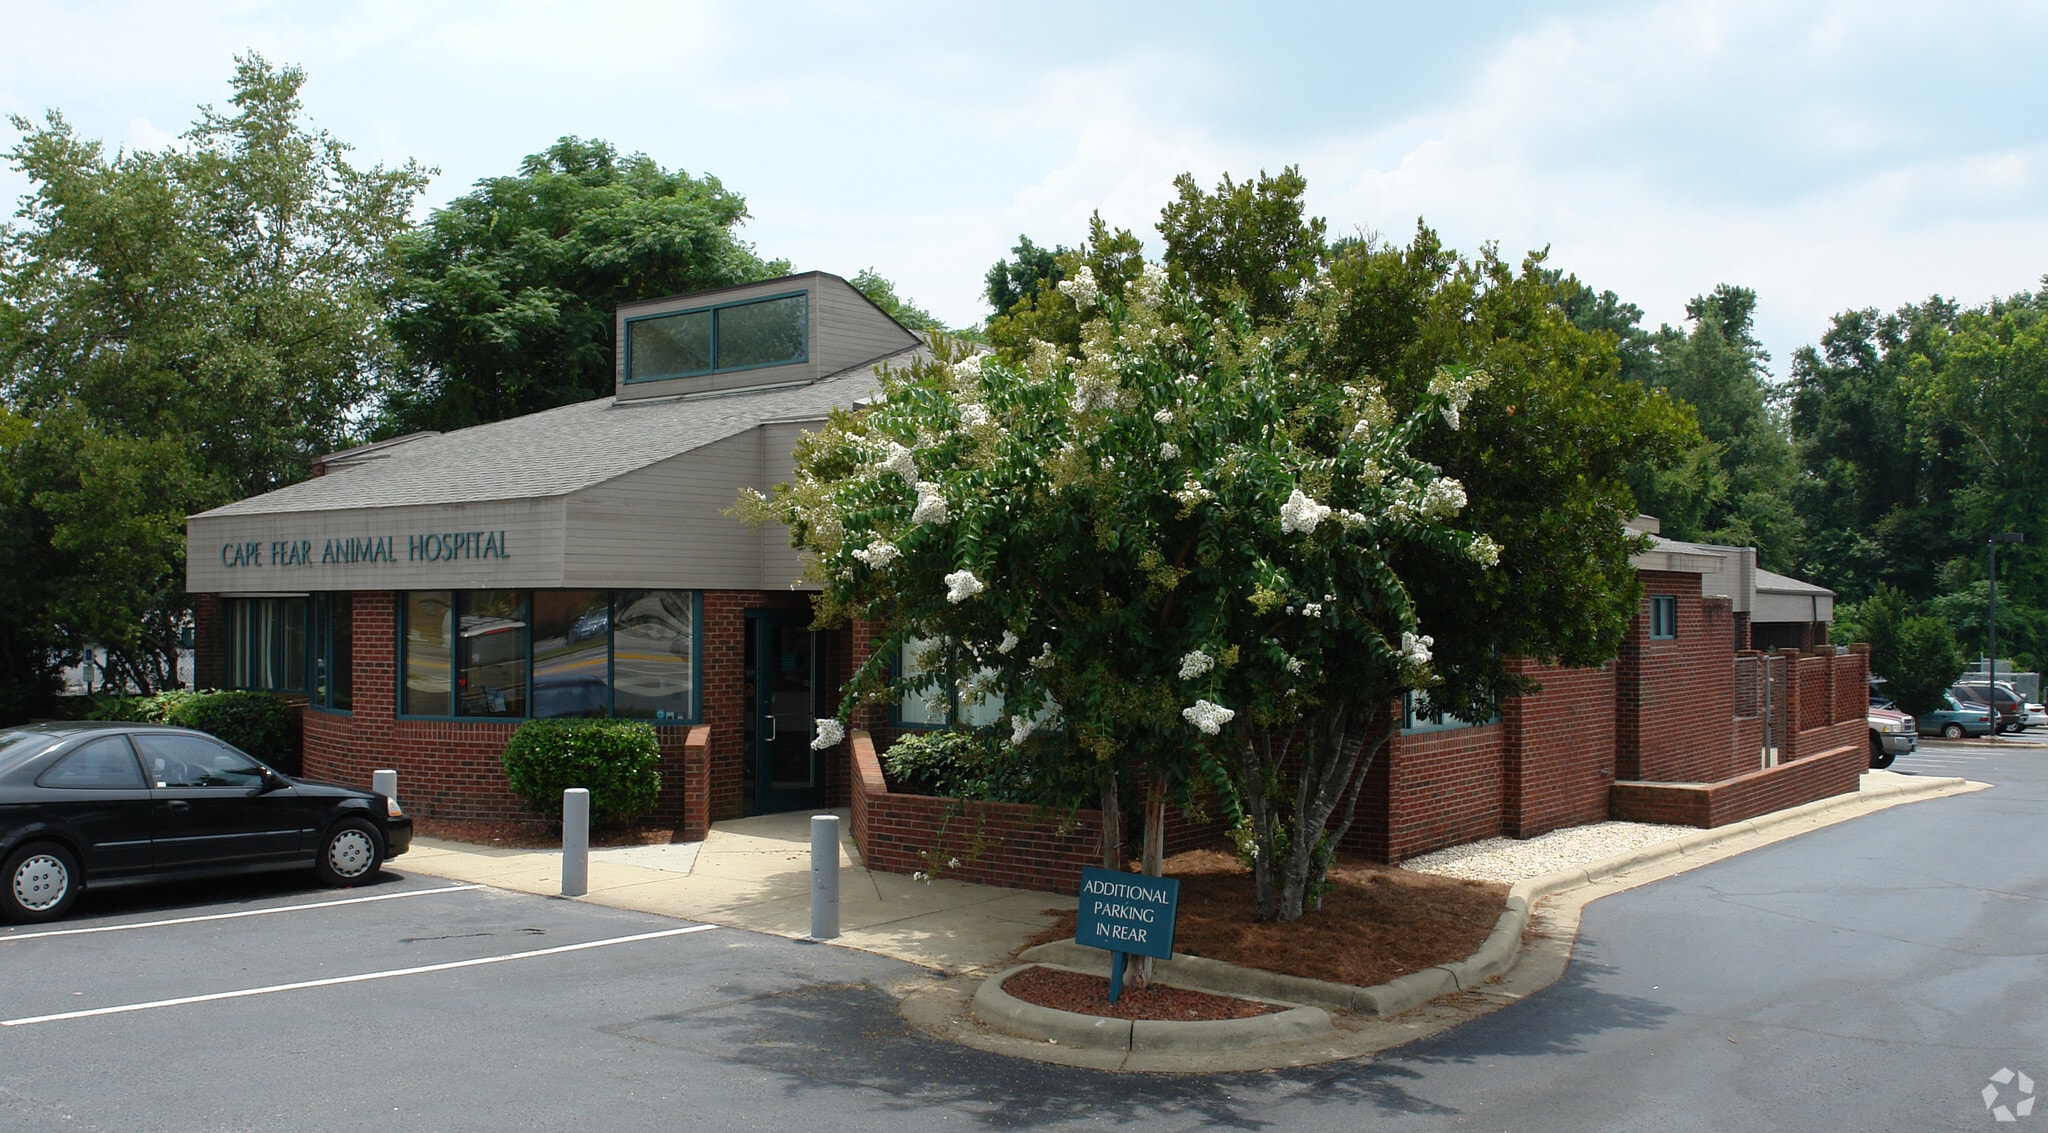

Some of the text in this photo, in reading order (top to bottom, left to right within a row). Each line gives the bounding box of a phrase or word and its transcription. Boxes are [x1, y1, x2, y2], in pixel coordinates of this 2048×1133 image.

[222, 530, 511, 567] CAPE FEAR ANIMAL HOSPITAL
[1083, 880, 1169, 904] ADDITIONAL
[1094, 902, 1154, 922] PARKING
[1096, 922, 1146, 942] IN REAR
